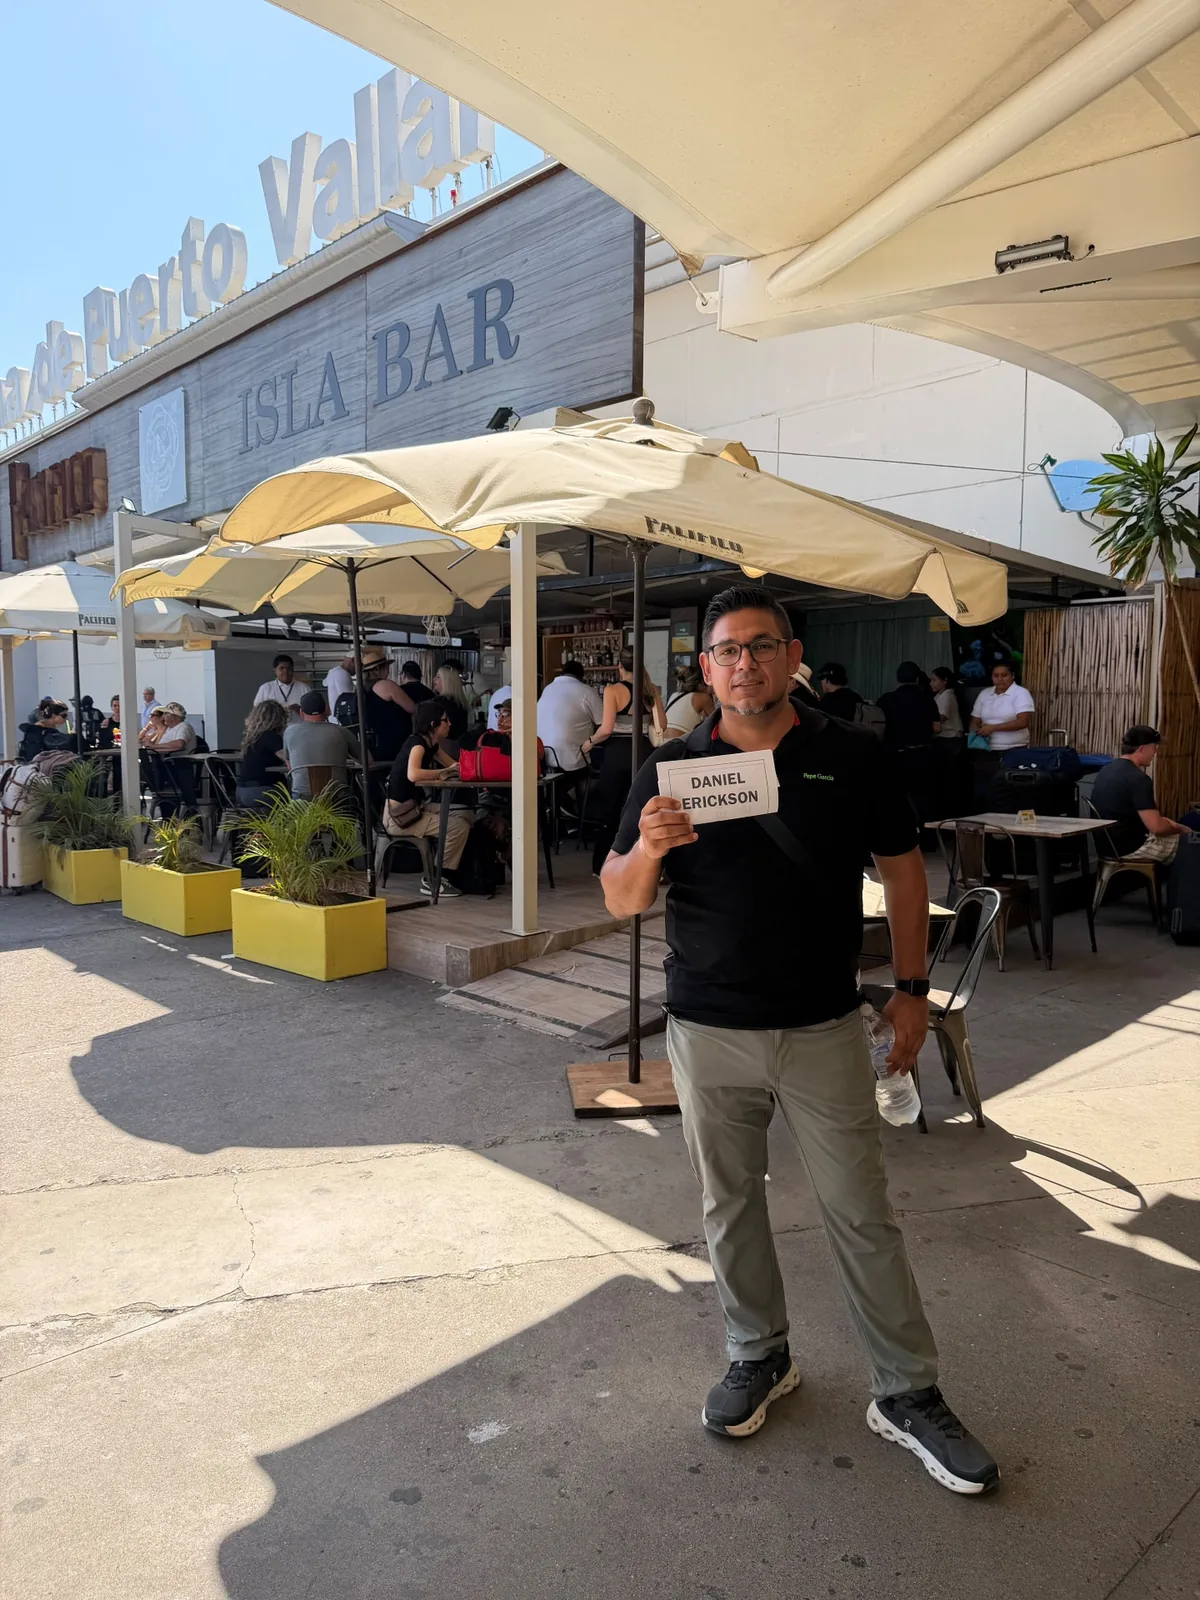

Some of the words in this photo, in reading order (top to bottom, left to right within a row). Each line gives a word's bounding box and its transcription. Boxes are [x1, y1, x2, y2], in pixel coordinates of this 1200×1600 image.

[83, 216, 248, 380] Puerto
[238, 351, 350, 454] ISLA
[372, 278, 520, 407] BAR
[78, 613, 116, 626] PACIFICO
[691, 772, 746, 789] DANIEL
[803, 772, 817, 780] Pepe
[682, 790, 759, 810] ERICKSON
